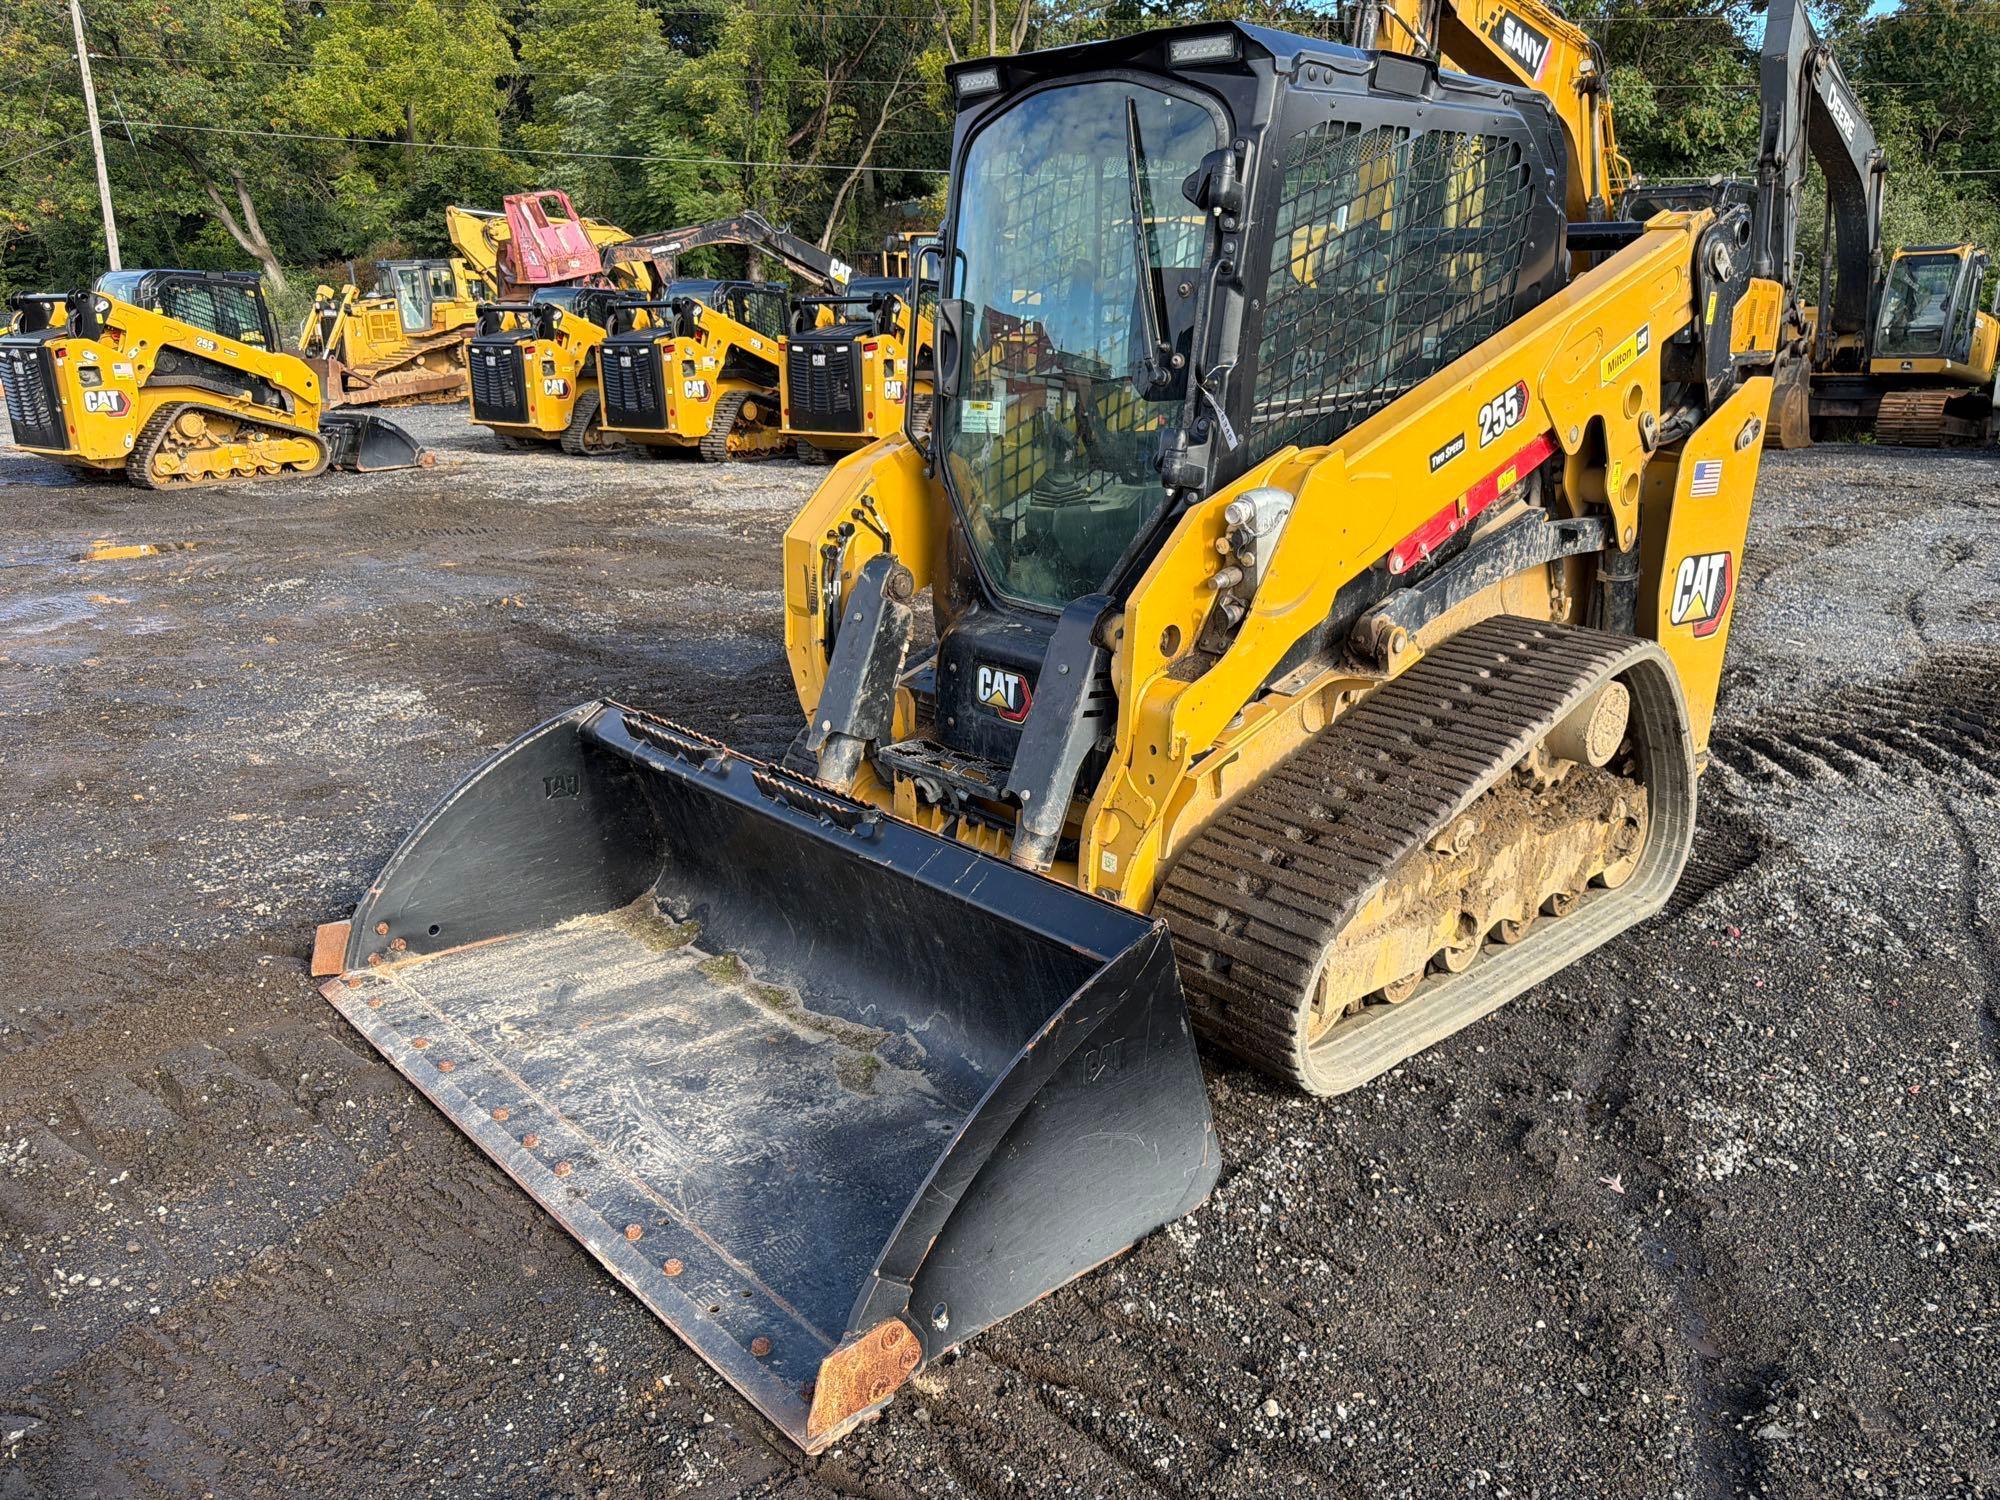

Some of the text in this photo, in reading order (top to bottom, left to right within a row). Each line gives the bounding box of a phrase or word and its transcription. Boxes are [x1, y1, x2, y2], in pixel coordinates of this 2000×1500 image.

[1503, 17, 1542, 68] SANY
[1827, 82, 1855, 143] DEERE
[830, 257, 852, 286] CAT
[196, 336, 214, 351] 255
[1607, 330, 1648, 375] Milton CAT
[812, 354, 827, 367] CAT
[84, 390, 119, 412] CAT
[544, 379, 565, 396] CAT
[684, 380, 706, 399] CAT
[884, 380, 902, 400] CAT
[1479, 384, 1519, 448] 255
[1671, 553, 1726, 624] CAT
[978, 667, 1019, 710] CAT
